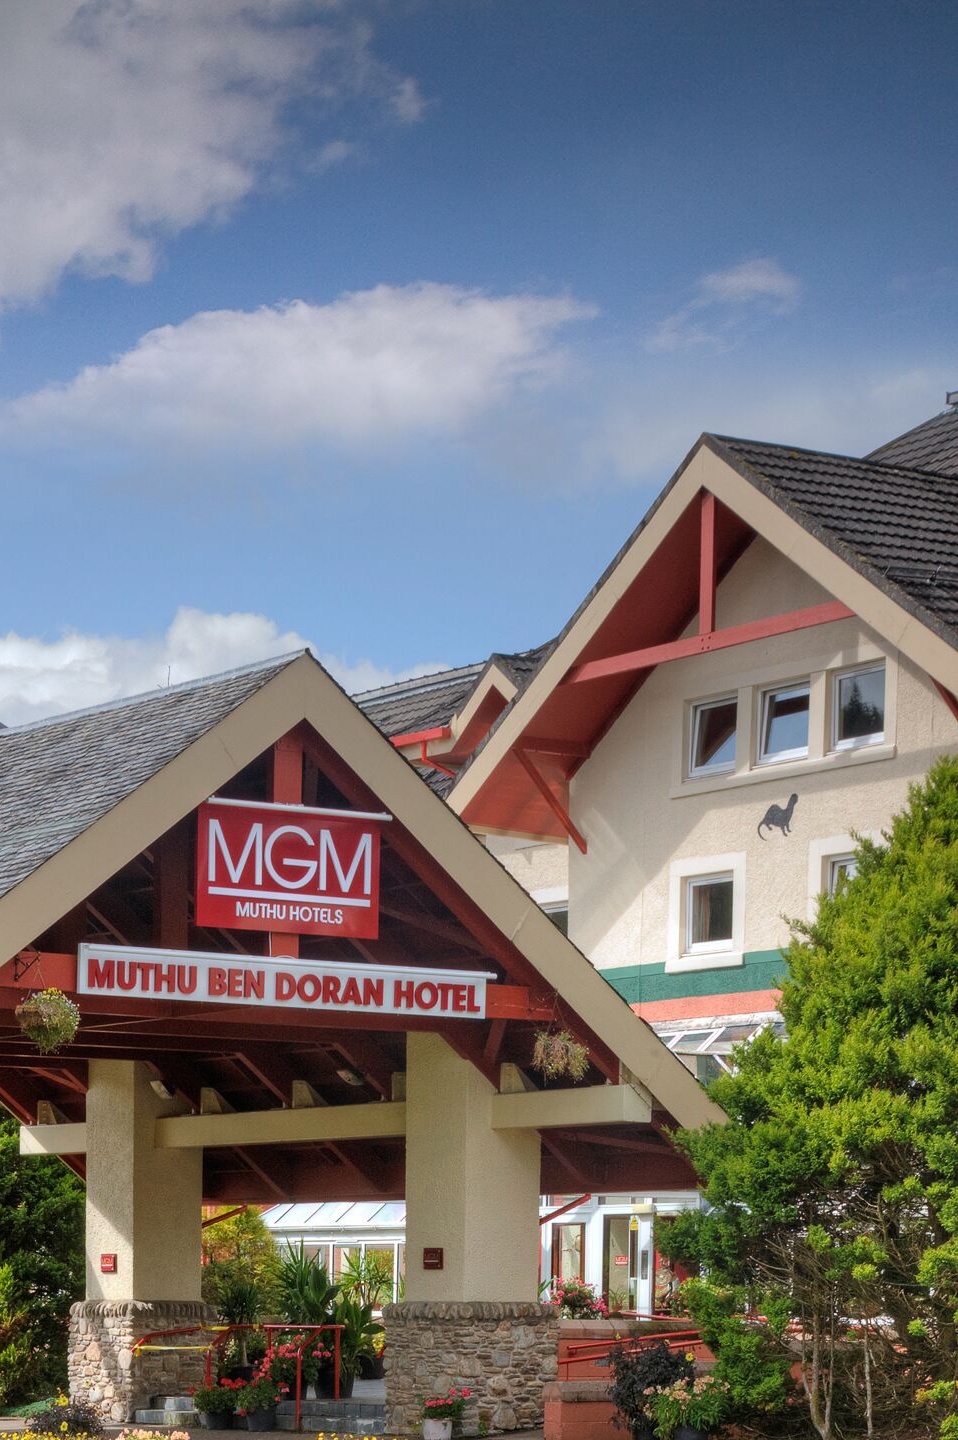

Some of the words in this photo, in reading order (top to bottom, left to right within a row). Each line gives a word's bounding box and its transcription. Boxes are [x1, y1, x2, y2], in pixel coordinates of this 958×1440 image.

[208, 819, 371, 895] MGM
[235, 901, 286, 920] MUTHU
[289, 905, 343, 925] HOTELS
[87, 959, 197, 994] MUTHU
[208, 967, 265, 998] BEN
[275, 972, 384, 1007] DORAN
[393, 980, 481, 1013] HOTEL
